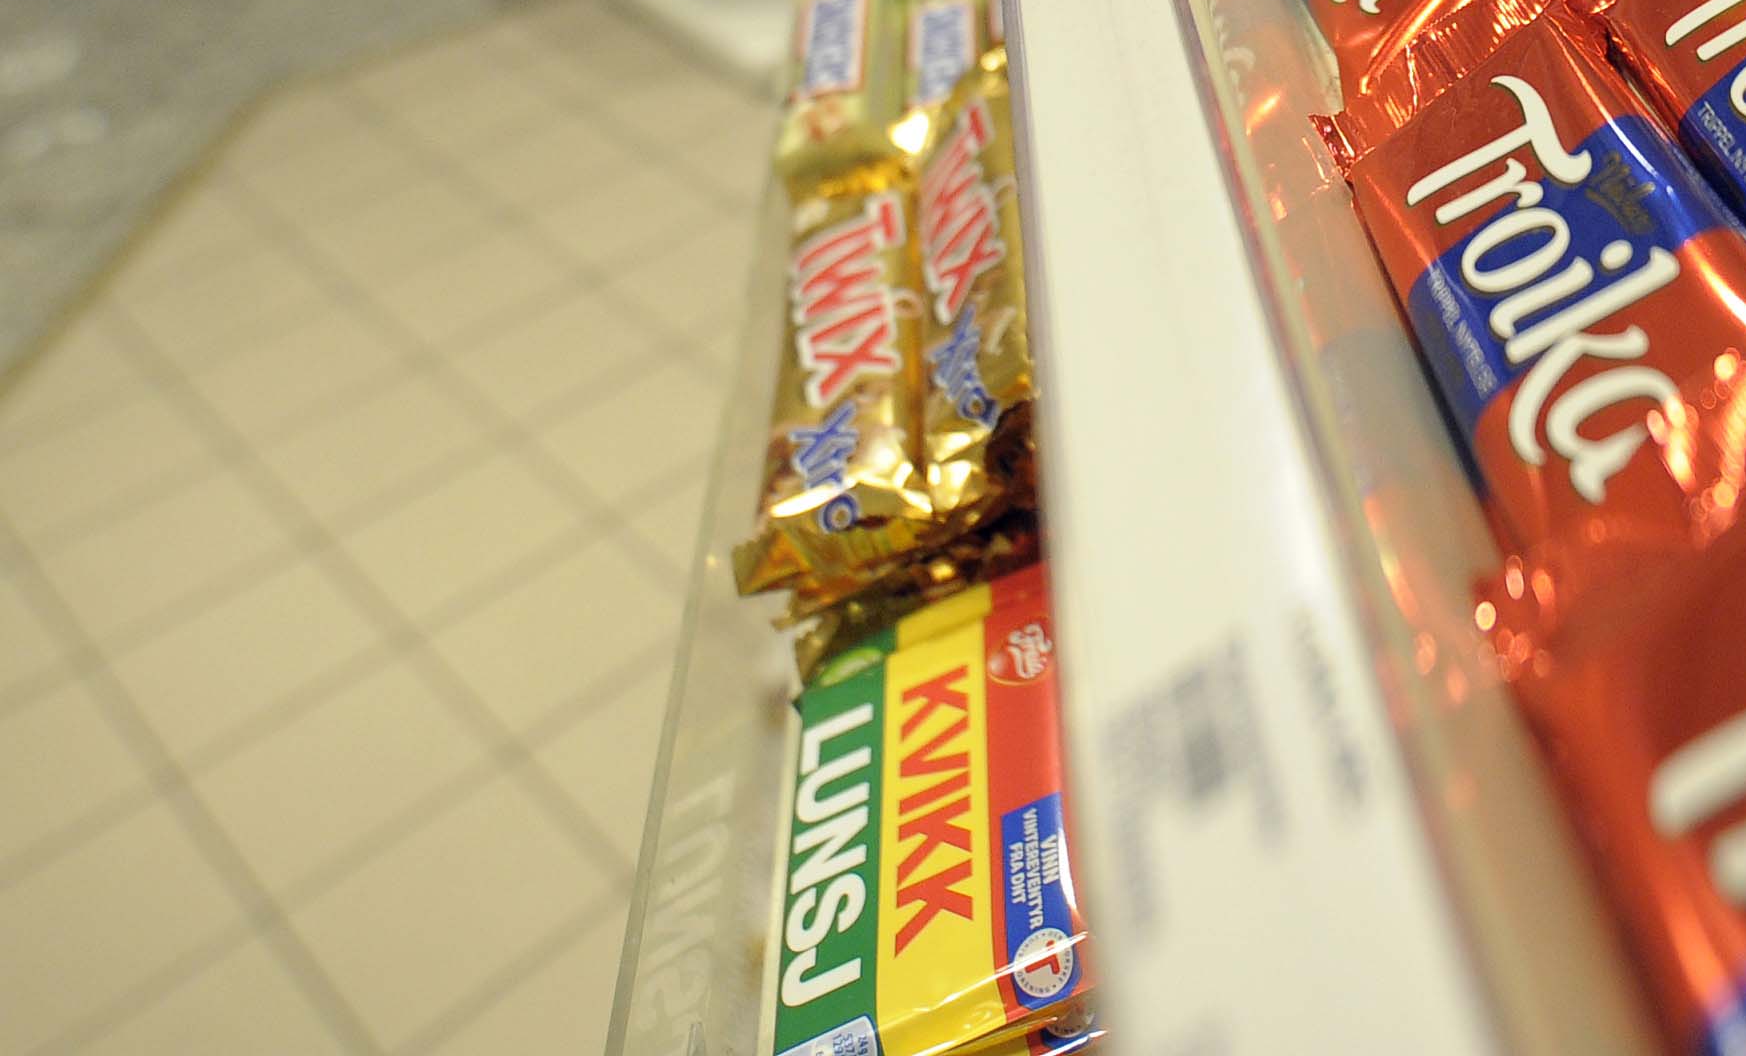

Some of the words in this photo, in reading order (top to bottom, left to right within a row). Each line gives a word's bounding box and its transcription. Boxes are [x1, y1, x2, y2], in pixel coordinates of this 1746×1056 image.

[921, 100, 1001, 323] TWIX
[1697, 101, 1736, 157] TRIPPEL
[795, 196, 899, 406] TWIX
[1407, 75, 1682, 504] Troika
[781, 703, 873, 1007] LUNSJ
[894, 664, 974, 959] KVIKK
[1009, 842, 1024, 872] FRA
[1011, 873, 1026, 904] DNT
[1022, 807, 1044, 930] VINTEREVENTYR
[1041, 834, 1060, 885] VINN
